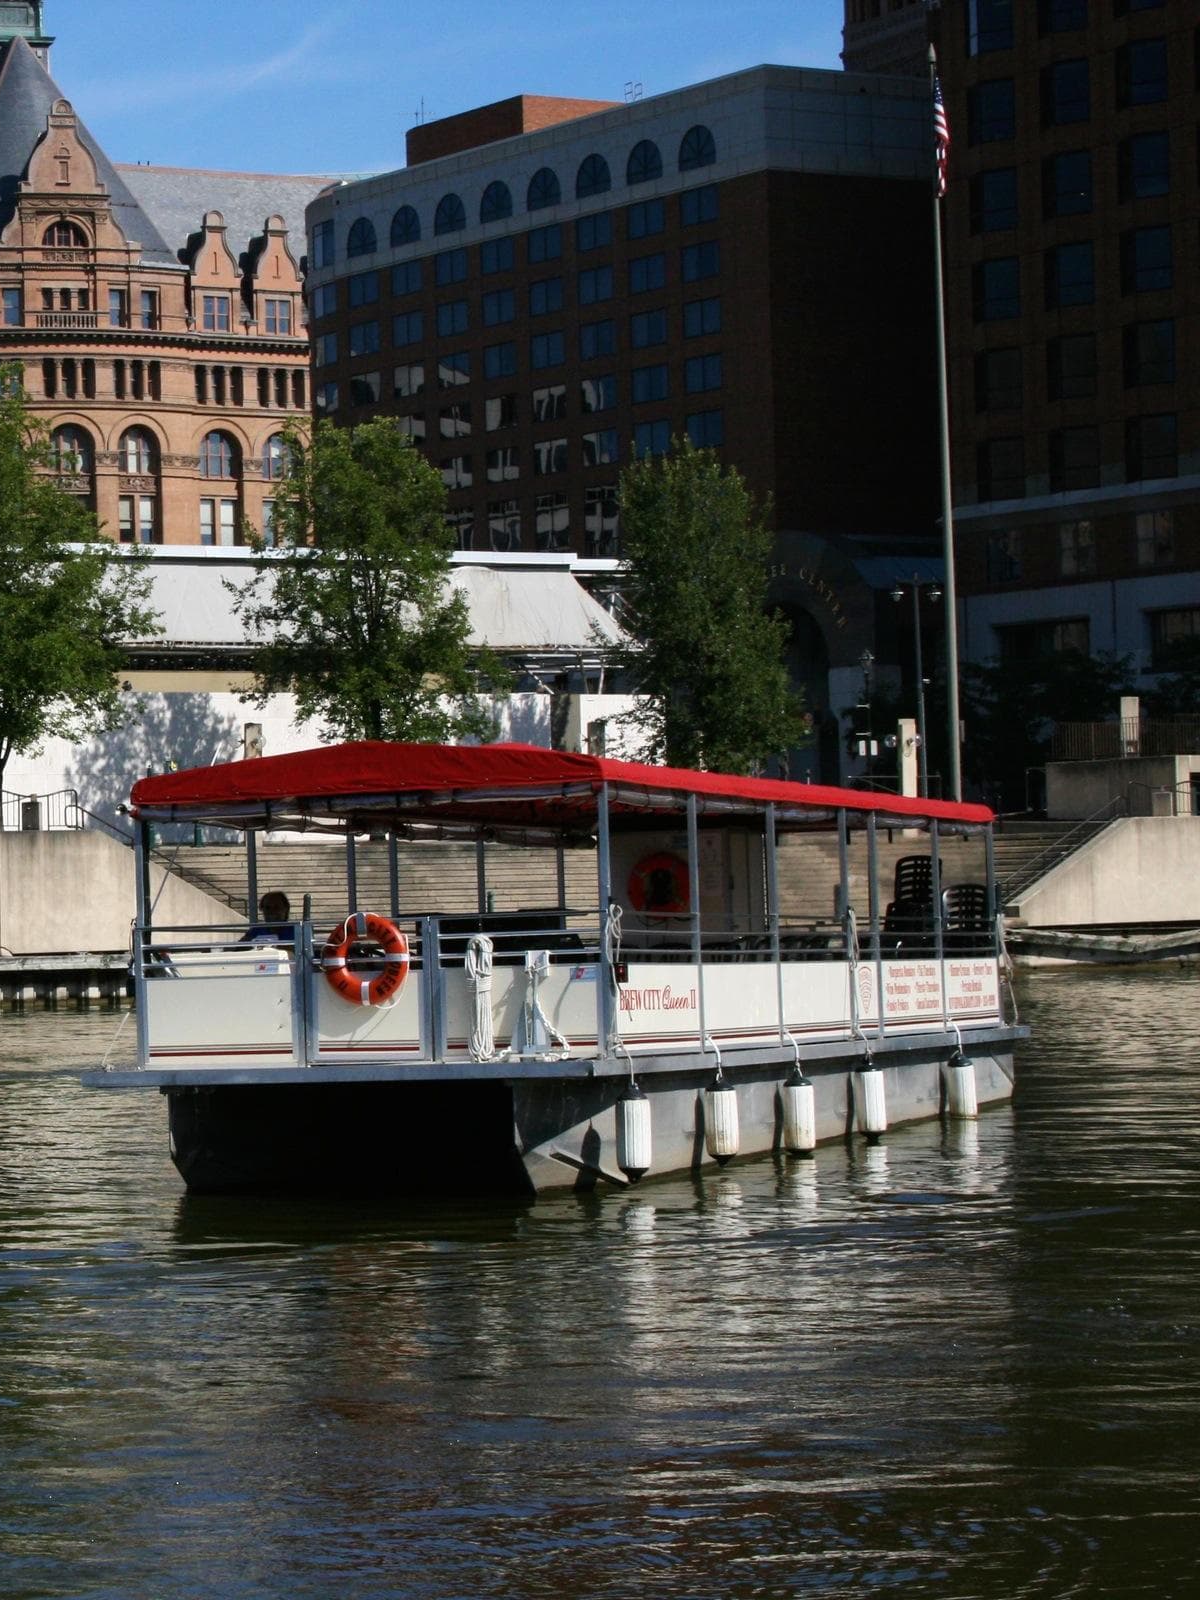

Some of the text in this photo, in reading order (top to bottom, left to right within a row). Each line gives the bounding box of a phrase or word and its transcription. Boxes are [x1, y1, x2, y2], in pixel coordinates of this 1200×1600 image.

[620, 989, 642, 1010] BREW
[643, 989, 661, 1010] CITY
[662, 985, 689, 1009] Queen
